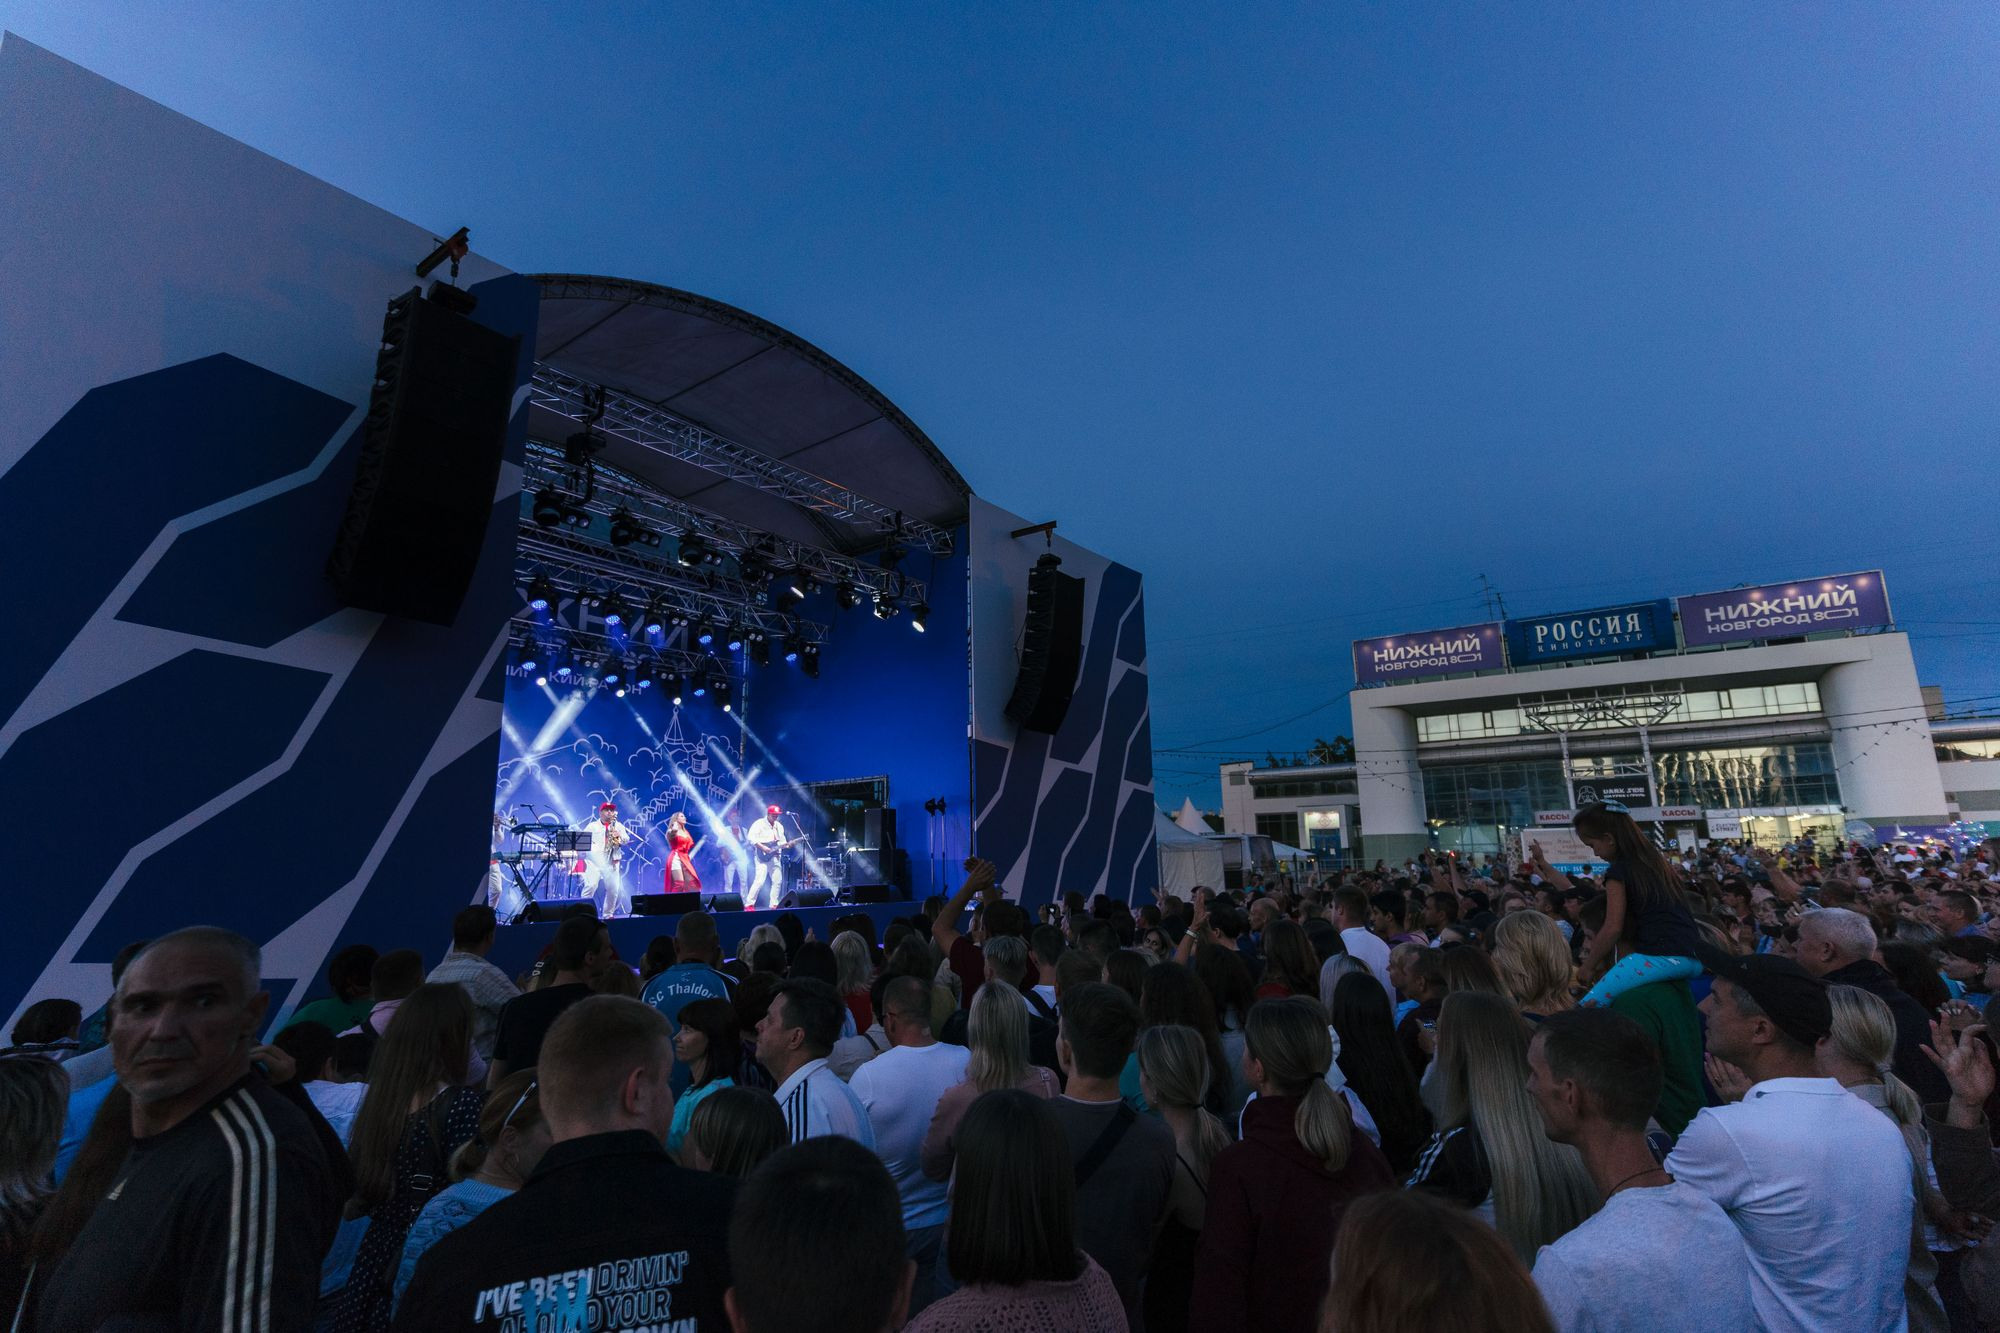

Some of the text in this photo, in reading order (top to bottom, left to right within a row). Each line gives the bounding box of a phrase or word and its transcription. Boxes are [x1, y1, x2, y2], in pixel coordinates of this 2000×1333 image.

[1704, 584, 1857, 622] НИЖНИЙ
[1534, 612, 1642, 644] РОССИЯ
[1707, 612, 1812, 634] НОВГОРОД
[1373, 633, 1481, 662] НИЖНИЙ
[1537, 633, 1643, 653] КИНОТЕАТР
[1375, 656, 1449, 673] НОВГОРОД
[473, 1280, 528, 1325] I'VE
[596, 1250, 689, 1297] DRIVIN'
[604, 1287, 673, 1330] YOUR
